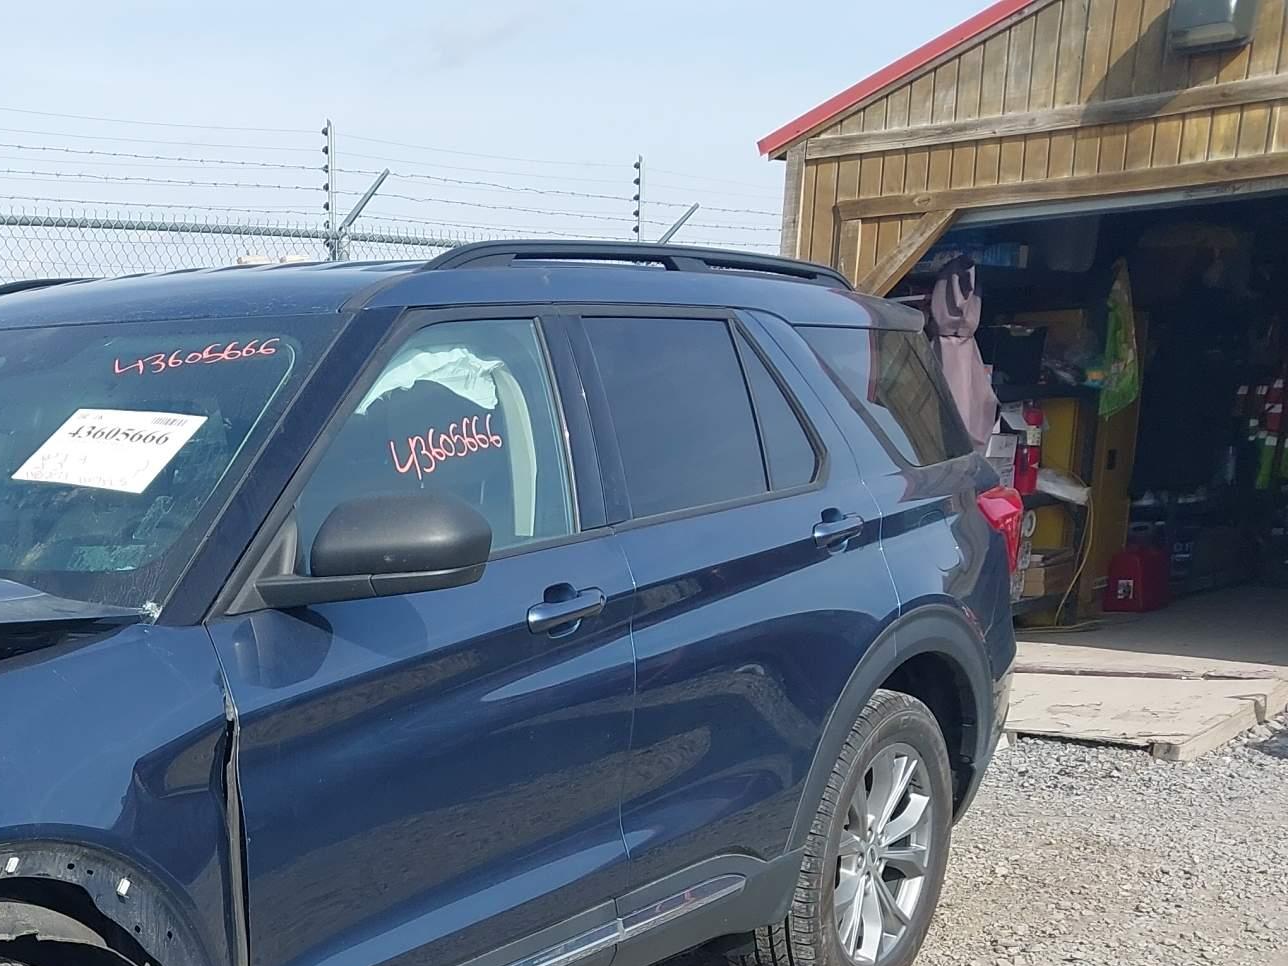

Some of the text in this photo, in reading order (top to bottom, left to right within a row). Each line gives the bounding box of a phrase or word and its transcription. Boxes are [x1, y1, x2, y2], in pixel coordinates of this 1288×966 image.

[114, 337, 280, 376] 43605666
[68, 424, 173, 446] 43605666
[389, 413, 503, 480] 43605666
